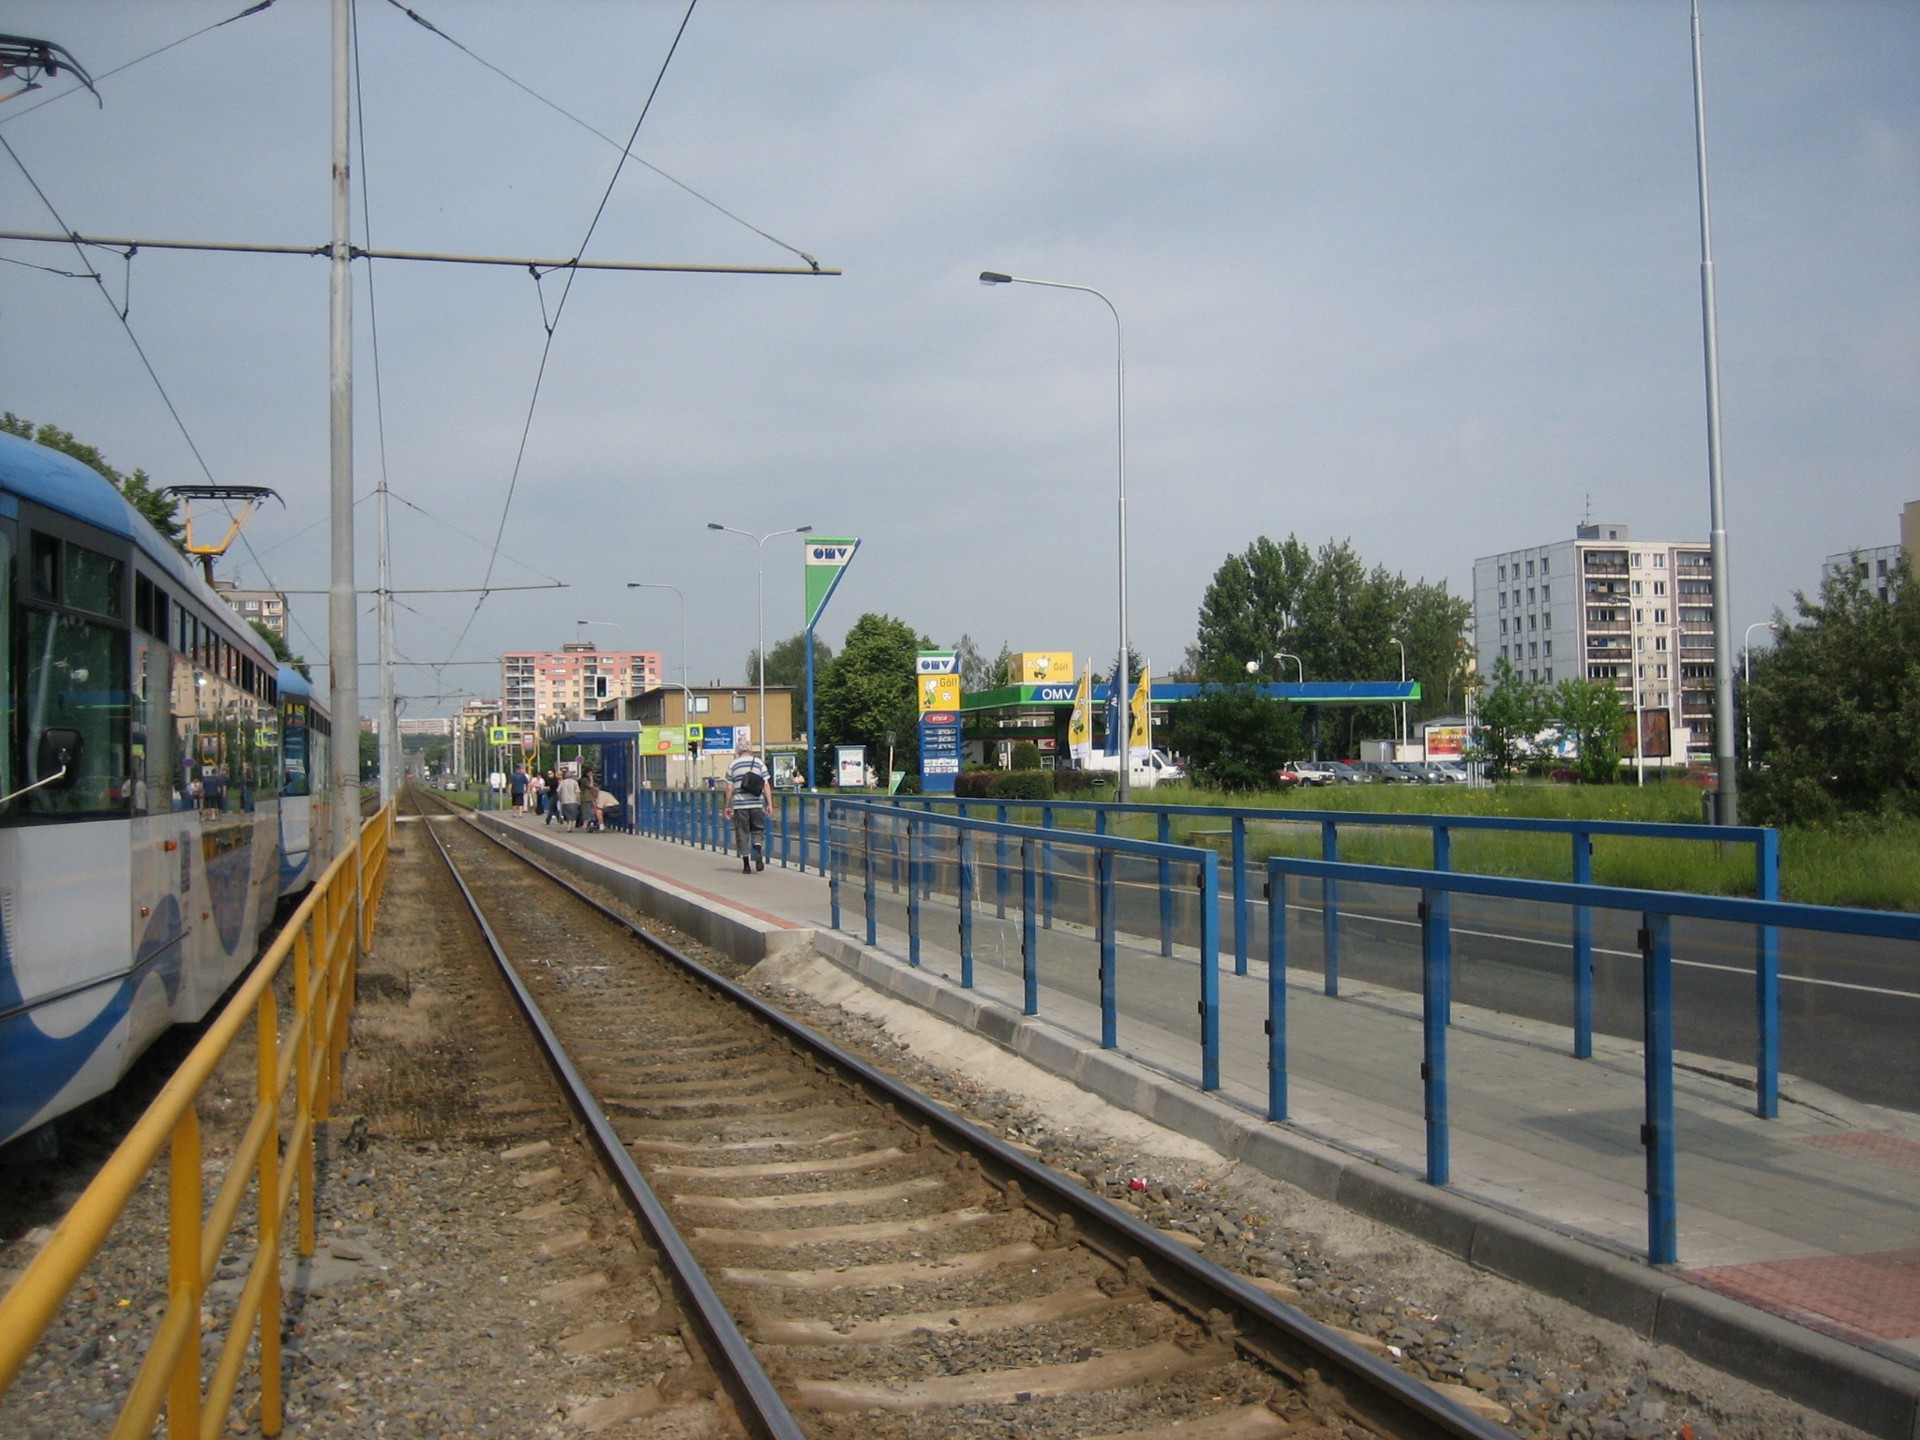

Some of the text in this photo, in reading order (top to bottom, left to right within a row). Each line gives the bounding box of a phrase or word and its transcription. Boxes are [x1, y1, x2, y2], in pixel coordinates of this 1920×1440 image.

[813, 547, 847, 560] OMV
[921, 660, 950, 670] OMV
[1042, 688, 1073, 700] OMV
